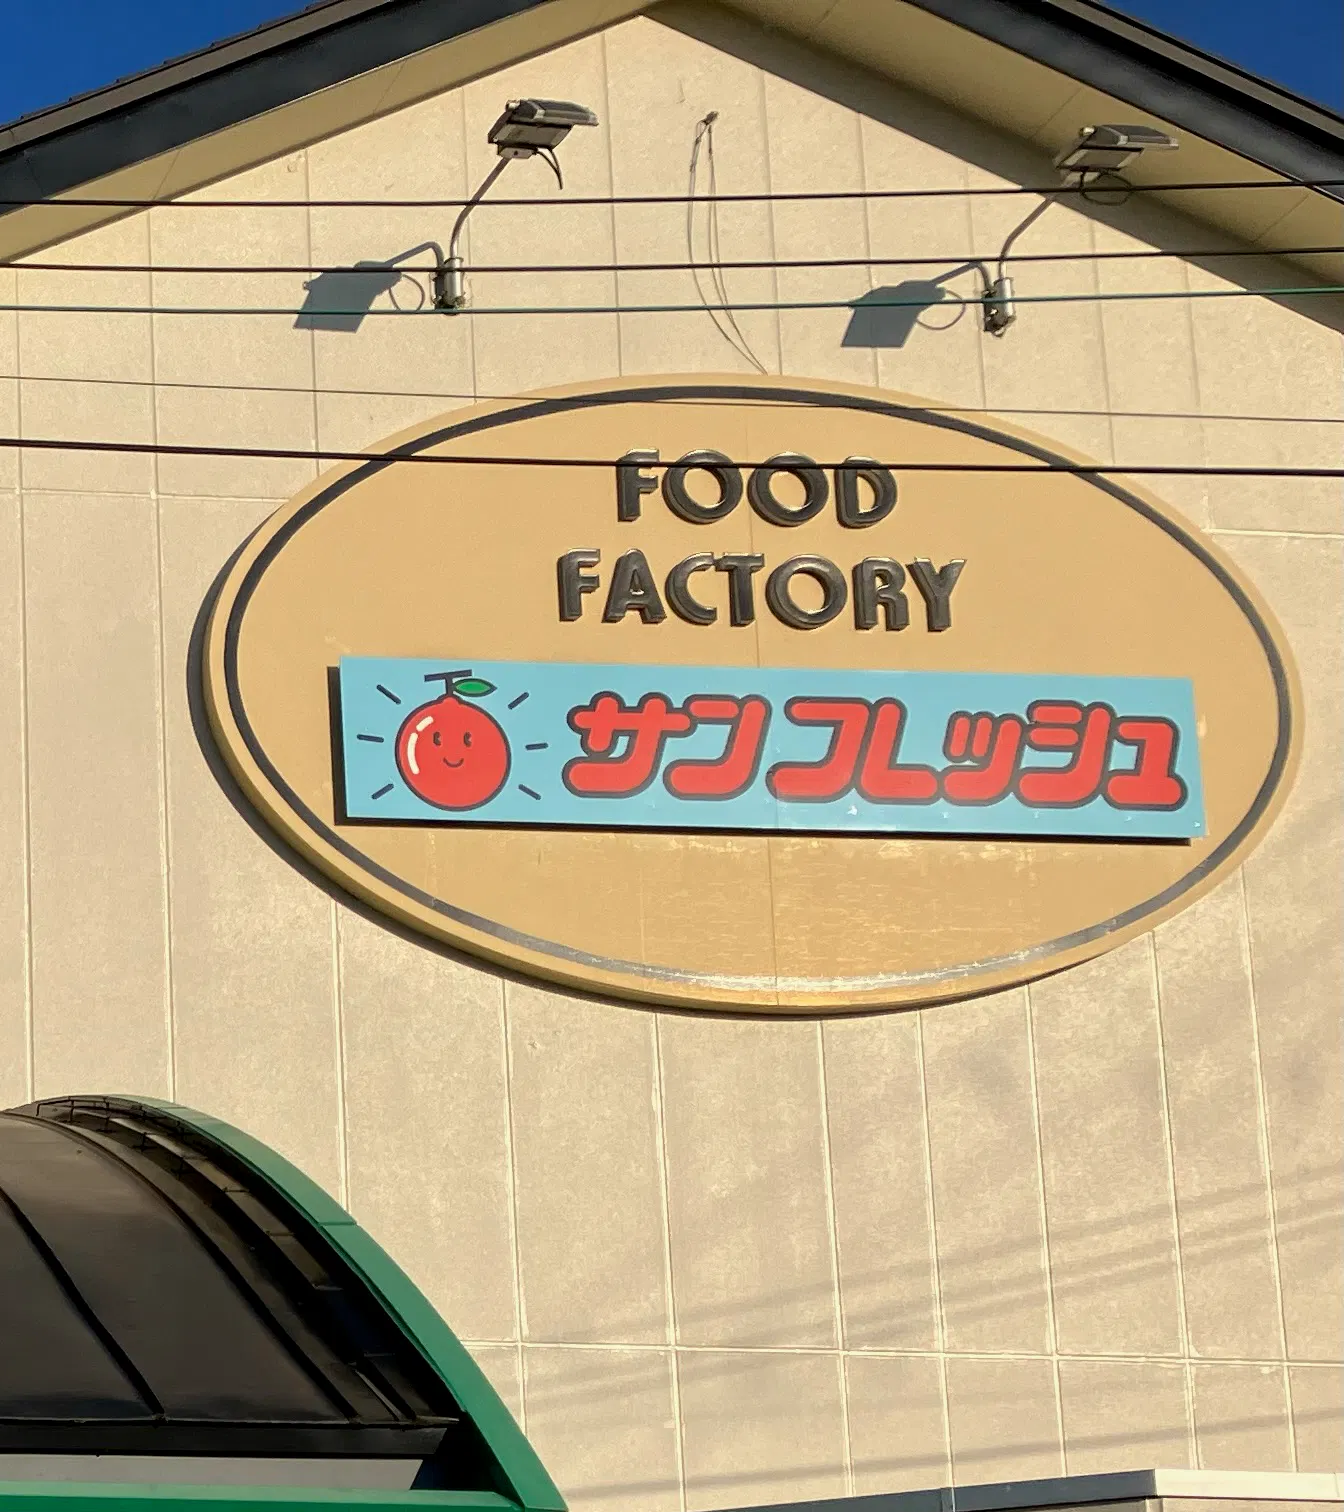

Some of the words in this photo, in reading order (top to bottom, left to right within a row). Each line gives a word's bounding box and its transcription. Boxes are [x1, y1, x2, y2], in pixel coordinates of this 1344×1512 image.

[615, 448, 898, 529] FOOD
[556, 547, 968, 633] FACTORY
[562, 691, 1189, 811] サンフレッシュ
